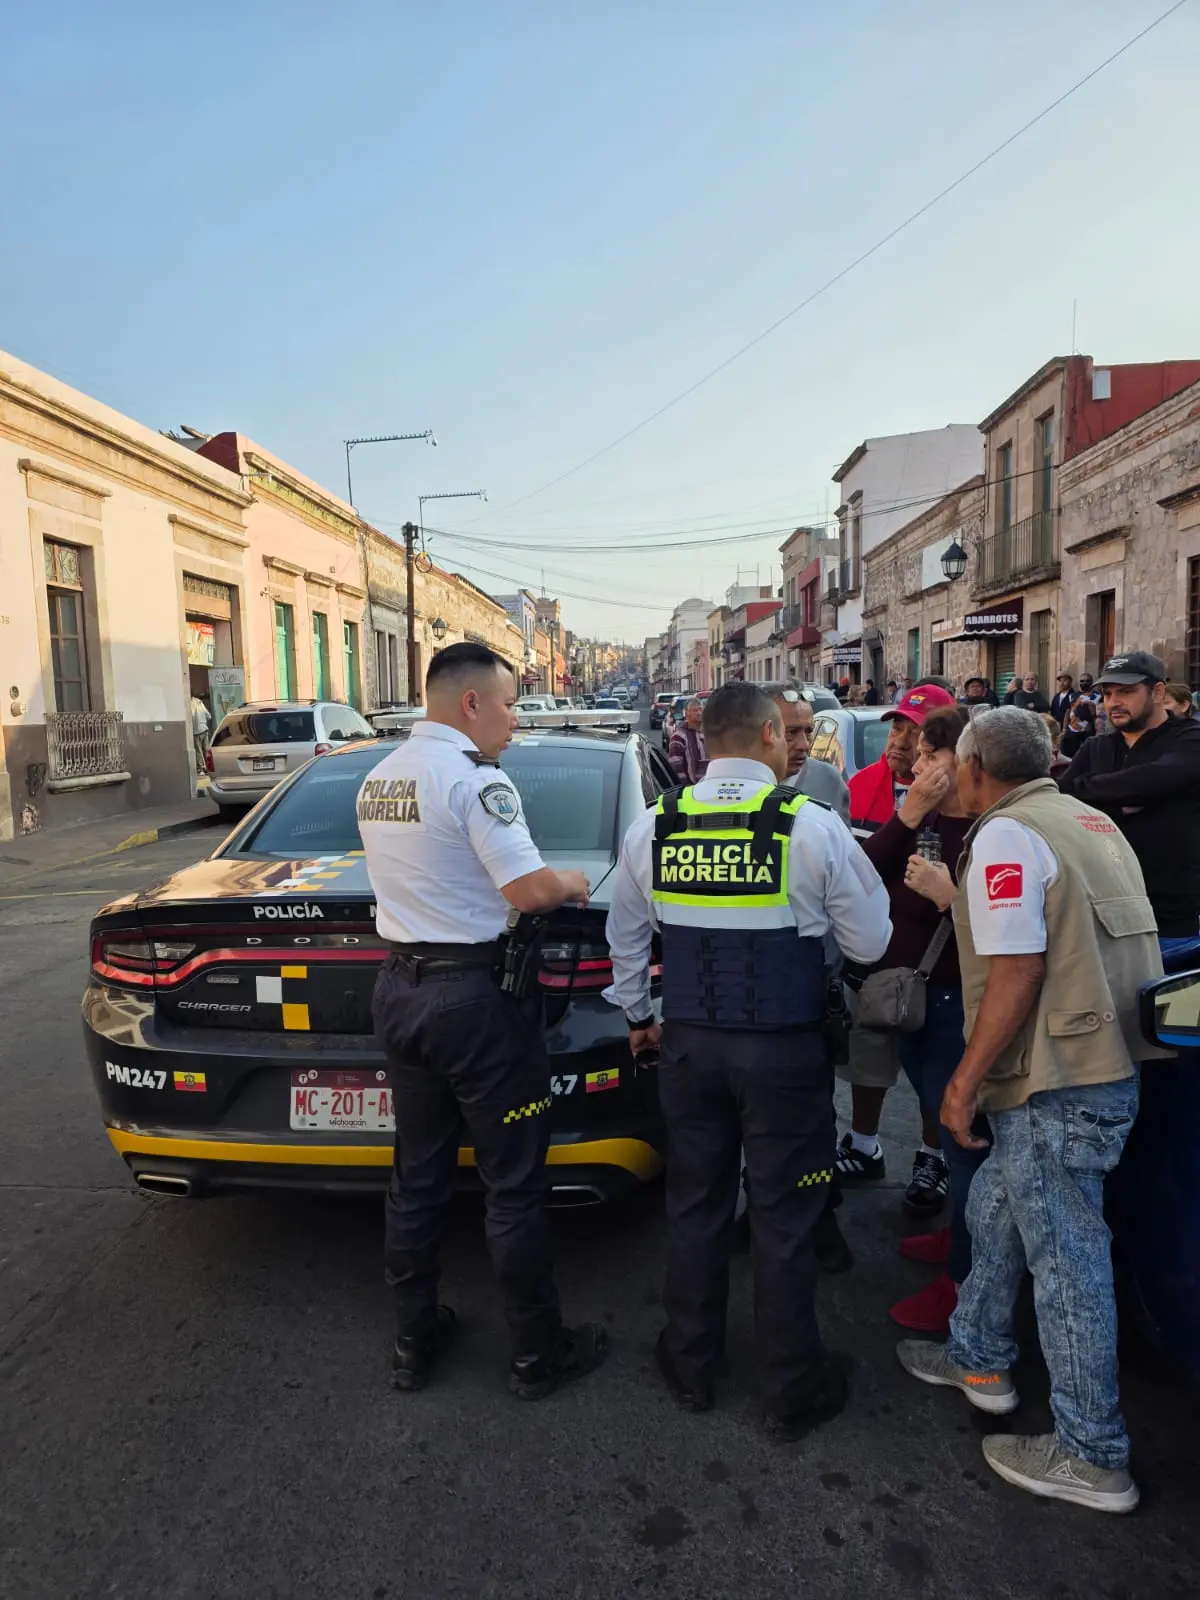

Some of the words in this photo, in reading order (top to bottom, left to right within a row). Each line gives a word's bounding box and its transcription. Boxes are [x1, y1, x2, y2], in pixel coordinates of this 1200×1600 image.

[965, 614, 1018, 625] ABARROTES
[358, 800, 421, 822] MORELIA
[660, 864, 774, 884] MORELIA
[253, 901, 325, 919] POLICÍA
[177, 1001, 252, 1013] CHARGER
[105, 1060, 167, 1090] PM247
